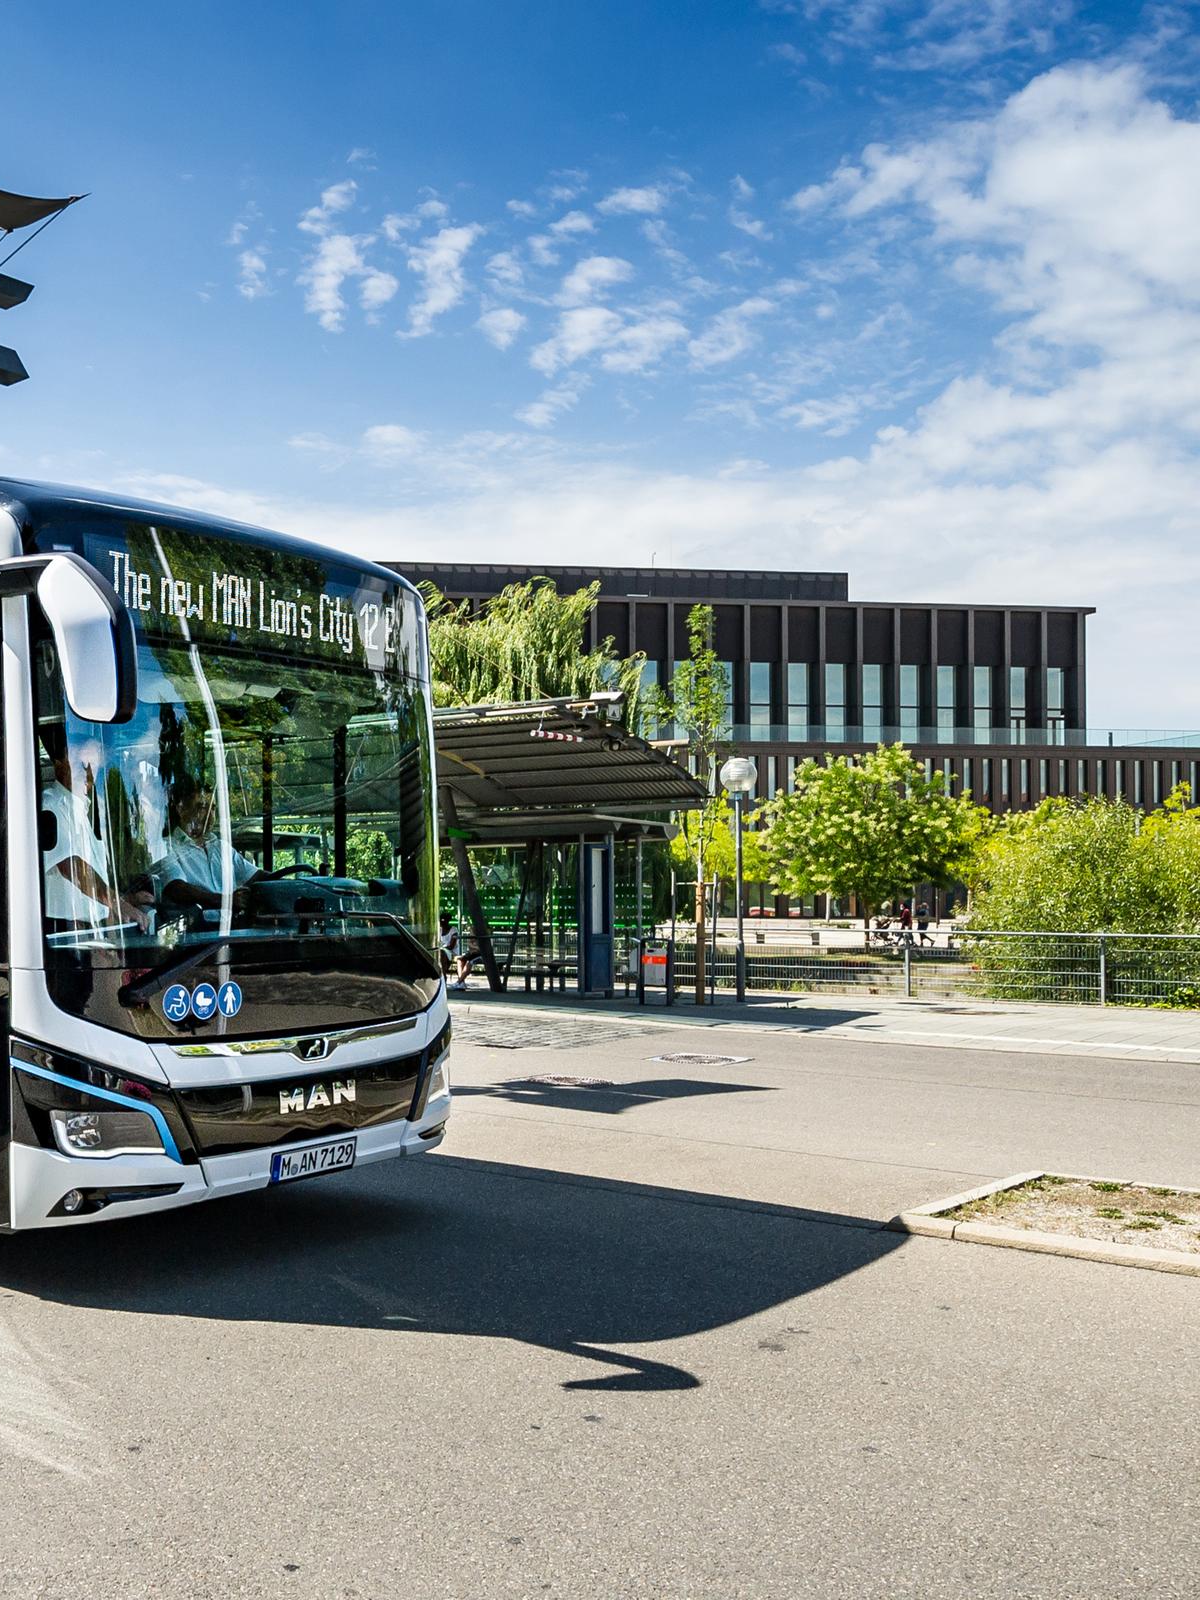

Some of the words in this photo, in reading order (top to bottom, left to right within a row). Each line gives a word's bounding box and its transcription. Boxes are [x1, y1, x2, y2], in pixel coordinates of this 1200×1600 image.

[108, 550, 151, 611] The
[160, 576, 204, 621] new
[212, 571, 251, 629] MAN
[259, 580, 312, 639] Lion's
[319, 593, 353, 654] City
[359, 602, 379, 650] 12
[385, 606, 395, 653] E
[279, 1079, 357, 1114] MAN
[320, 1143, 353, 1169] 7129
